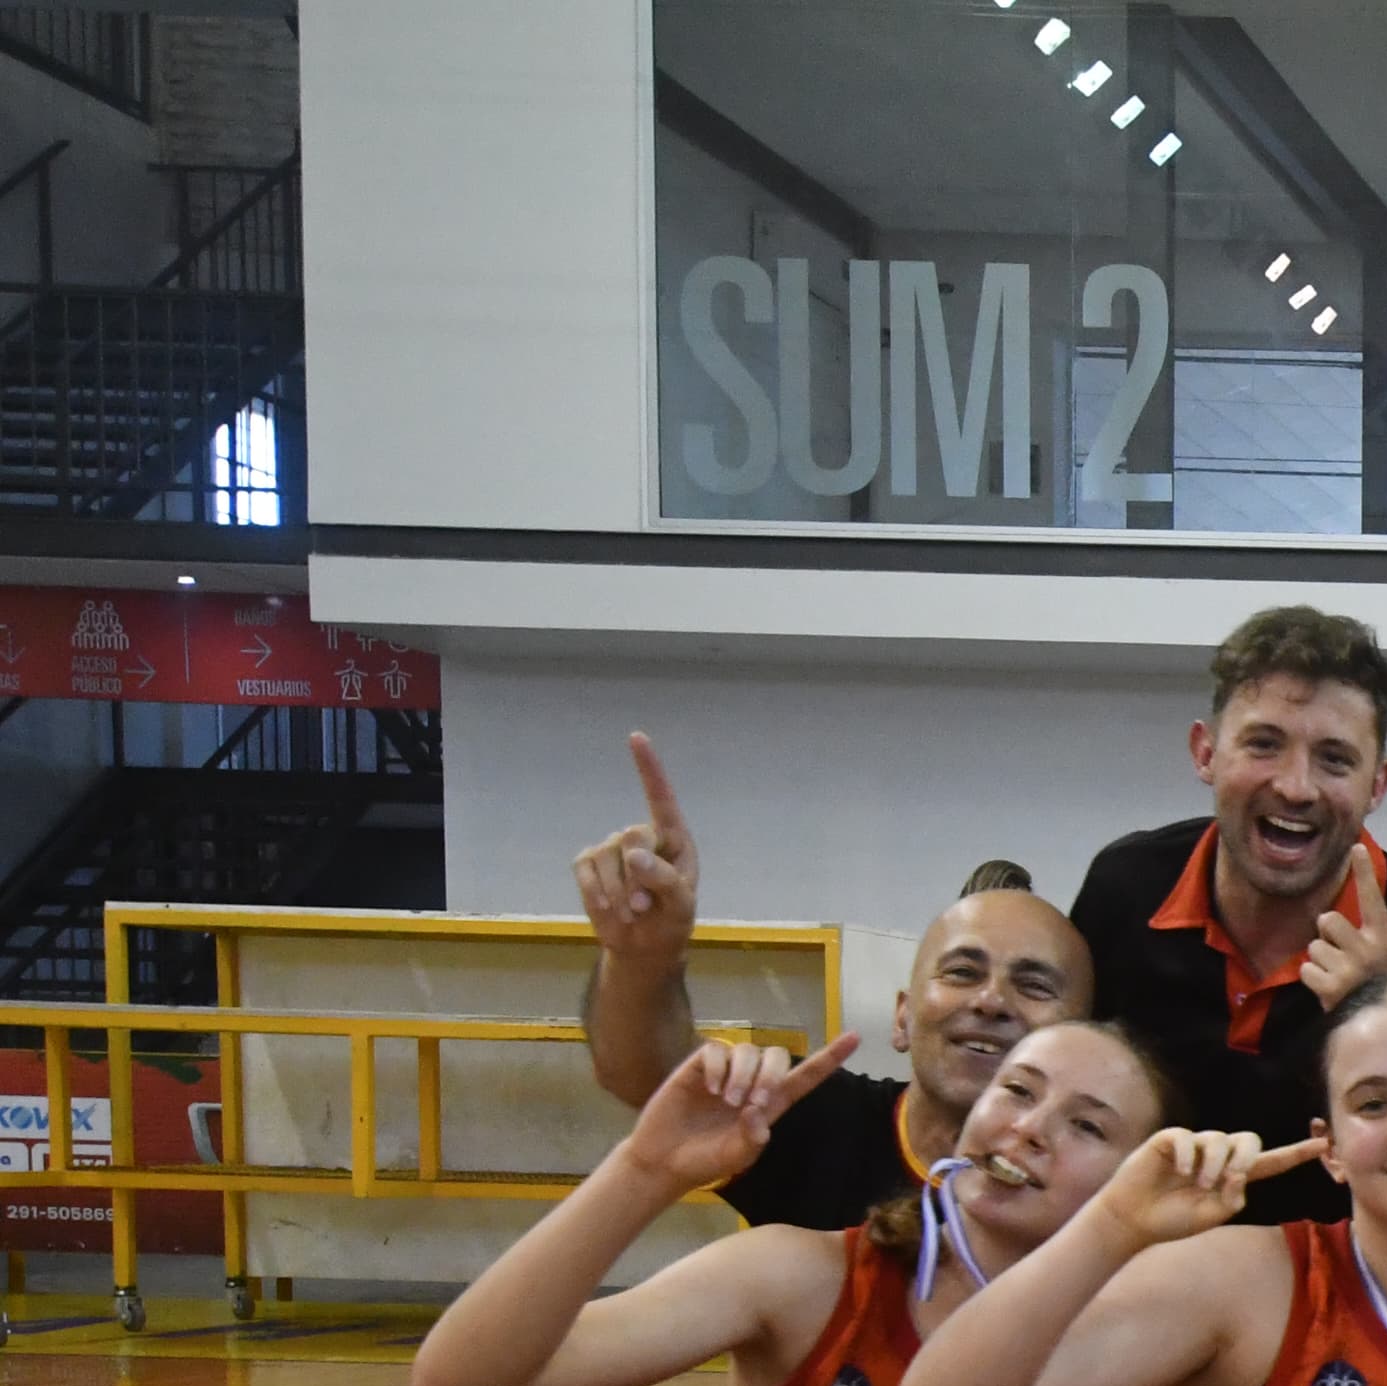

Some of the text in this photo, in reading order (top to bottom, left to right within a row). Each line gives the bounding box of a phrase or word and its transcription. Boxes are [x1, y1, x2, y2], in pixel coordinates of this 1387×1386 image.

[681, 256, 1173, 502] SUM 2
[237, 679, 312, 698] VESTUARIOS
